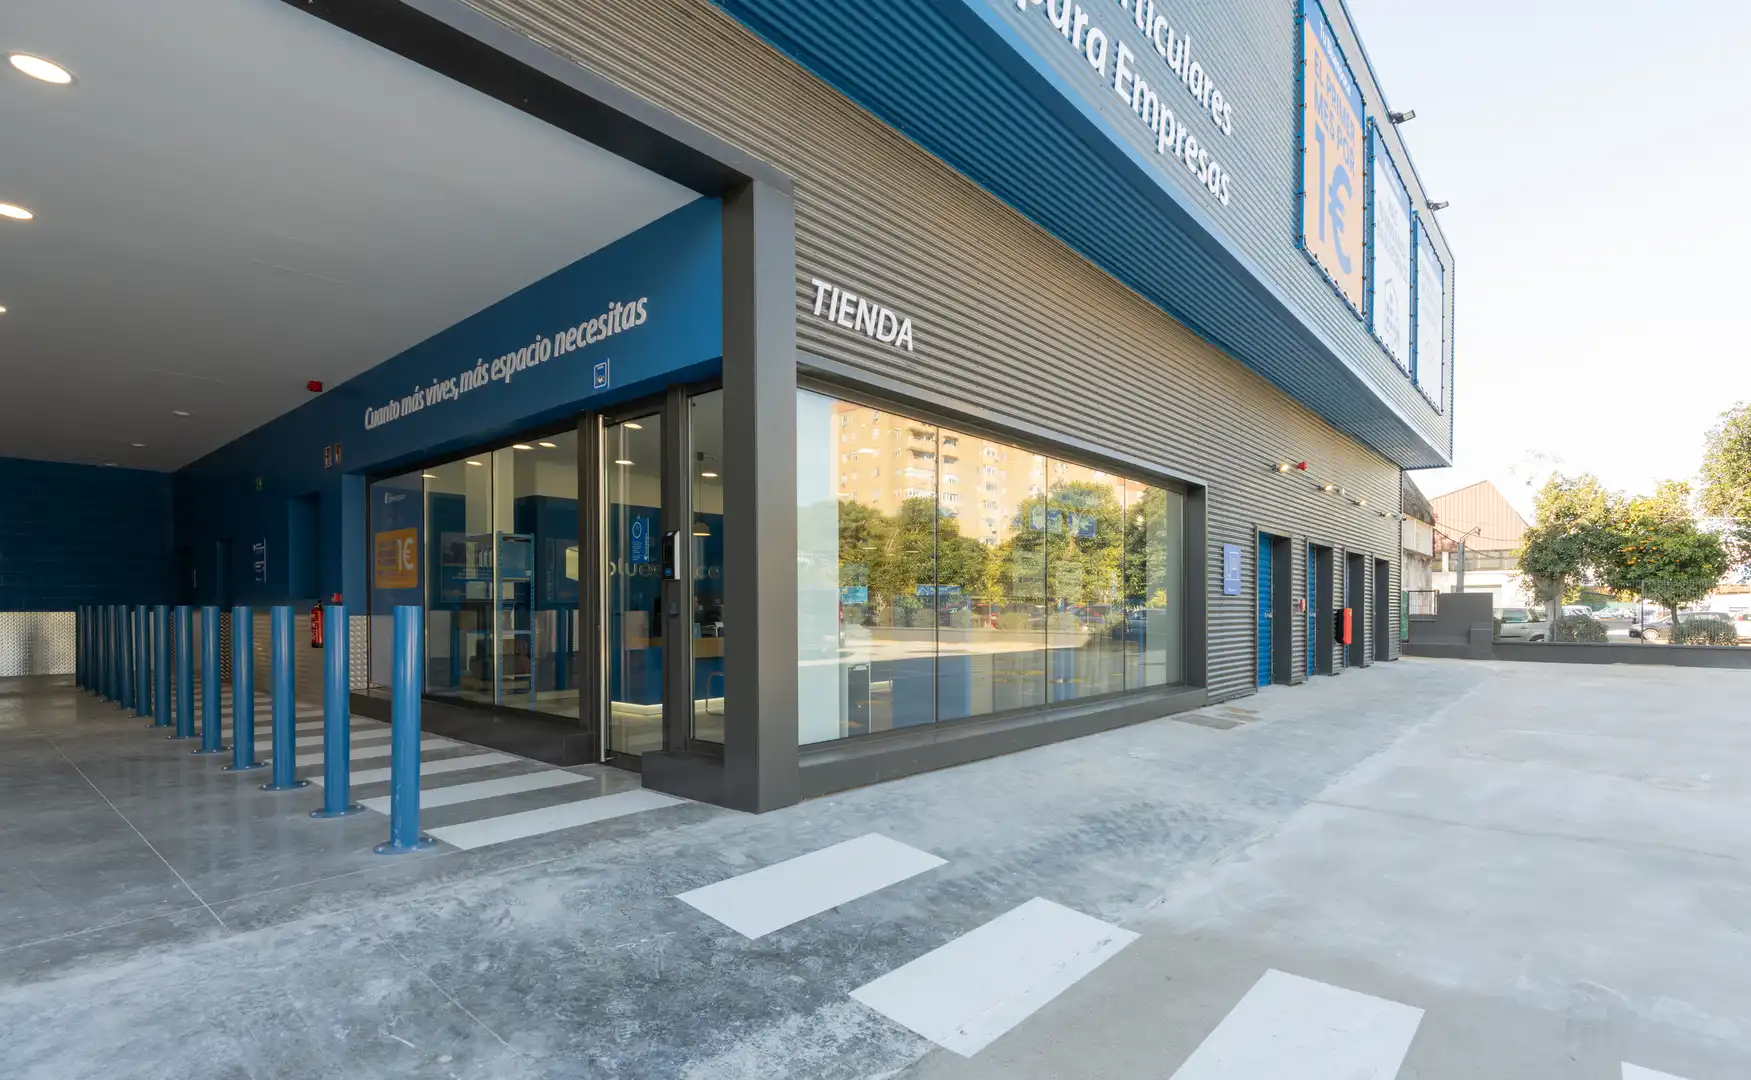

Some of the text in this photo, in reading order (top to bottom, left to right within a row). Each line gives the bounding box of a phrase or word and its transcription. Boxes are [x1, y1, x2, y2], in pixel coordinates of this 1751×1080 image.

[1016, 0, 1108, 77] ara
[1115, 40, 1230, 206] Empresas
[1120, 0, 1232, 136] ticulares
[1314, 48, 1324, 88] EL
[1326, 72, 1355, 150] PRIMER
[1314, 80, 1355, 178] MES POR
[1314, 121, 1352, 275] 1€
[364, 297, 648, 430] Cuanto más vives, más espacio necesitas
[811, 278, 913, 352] TIENDA
